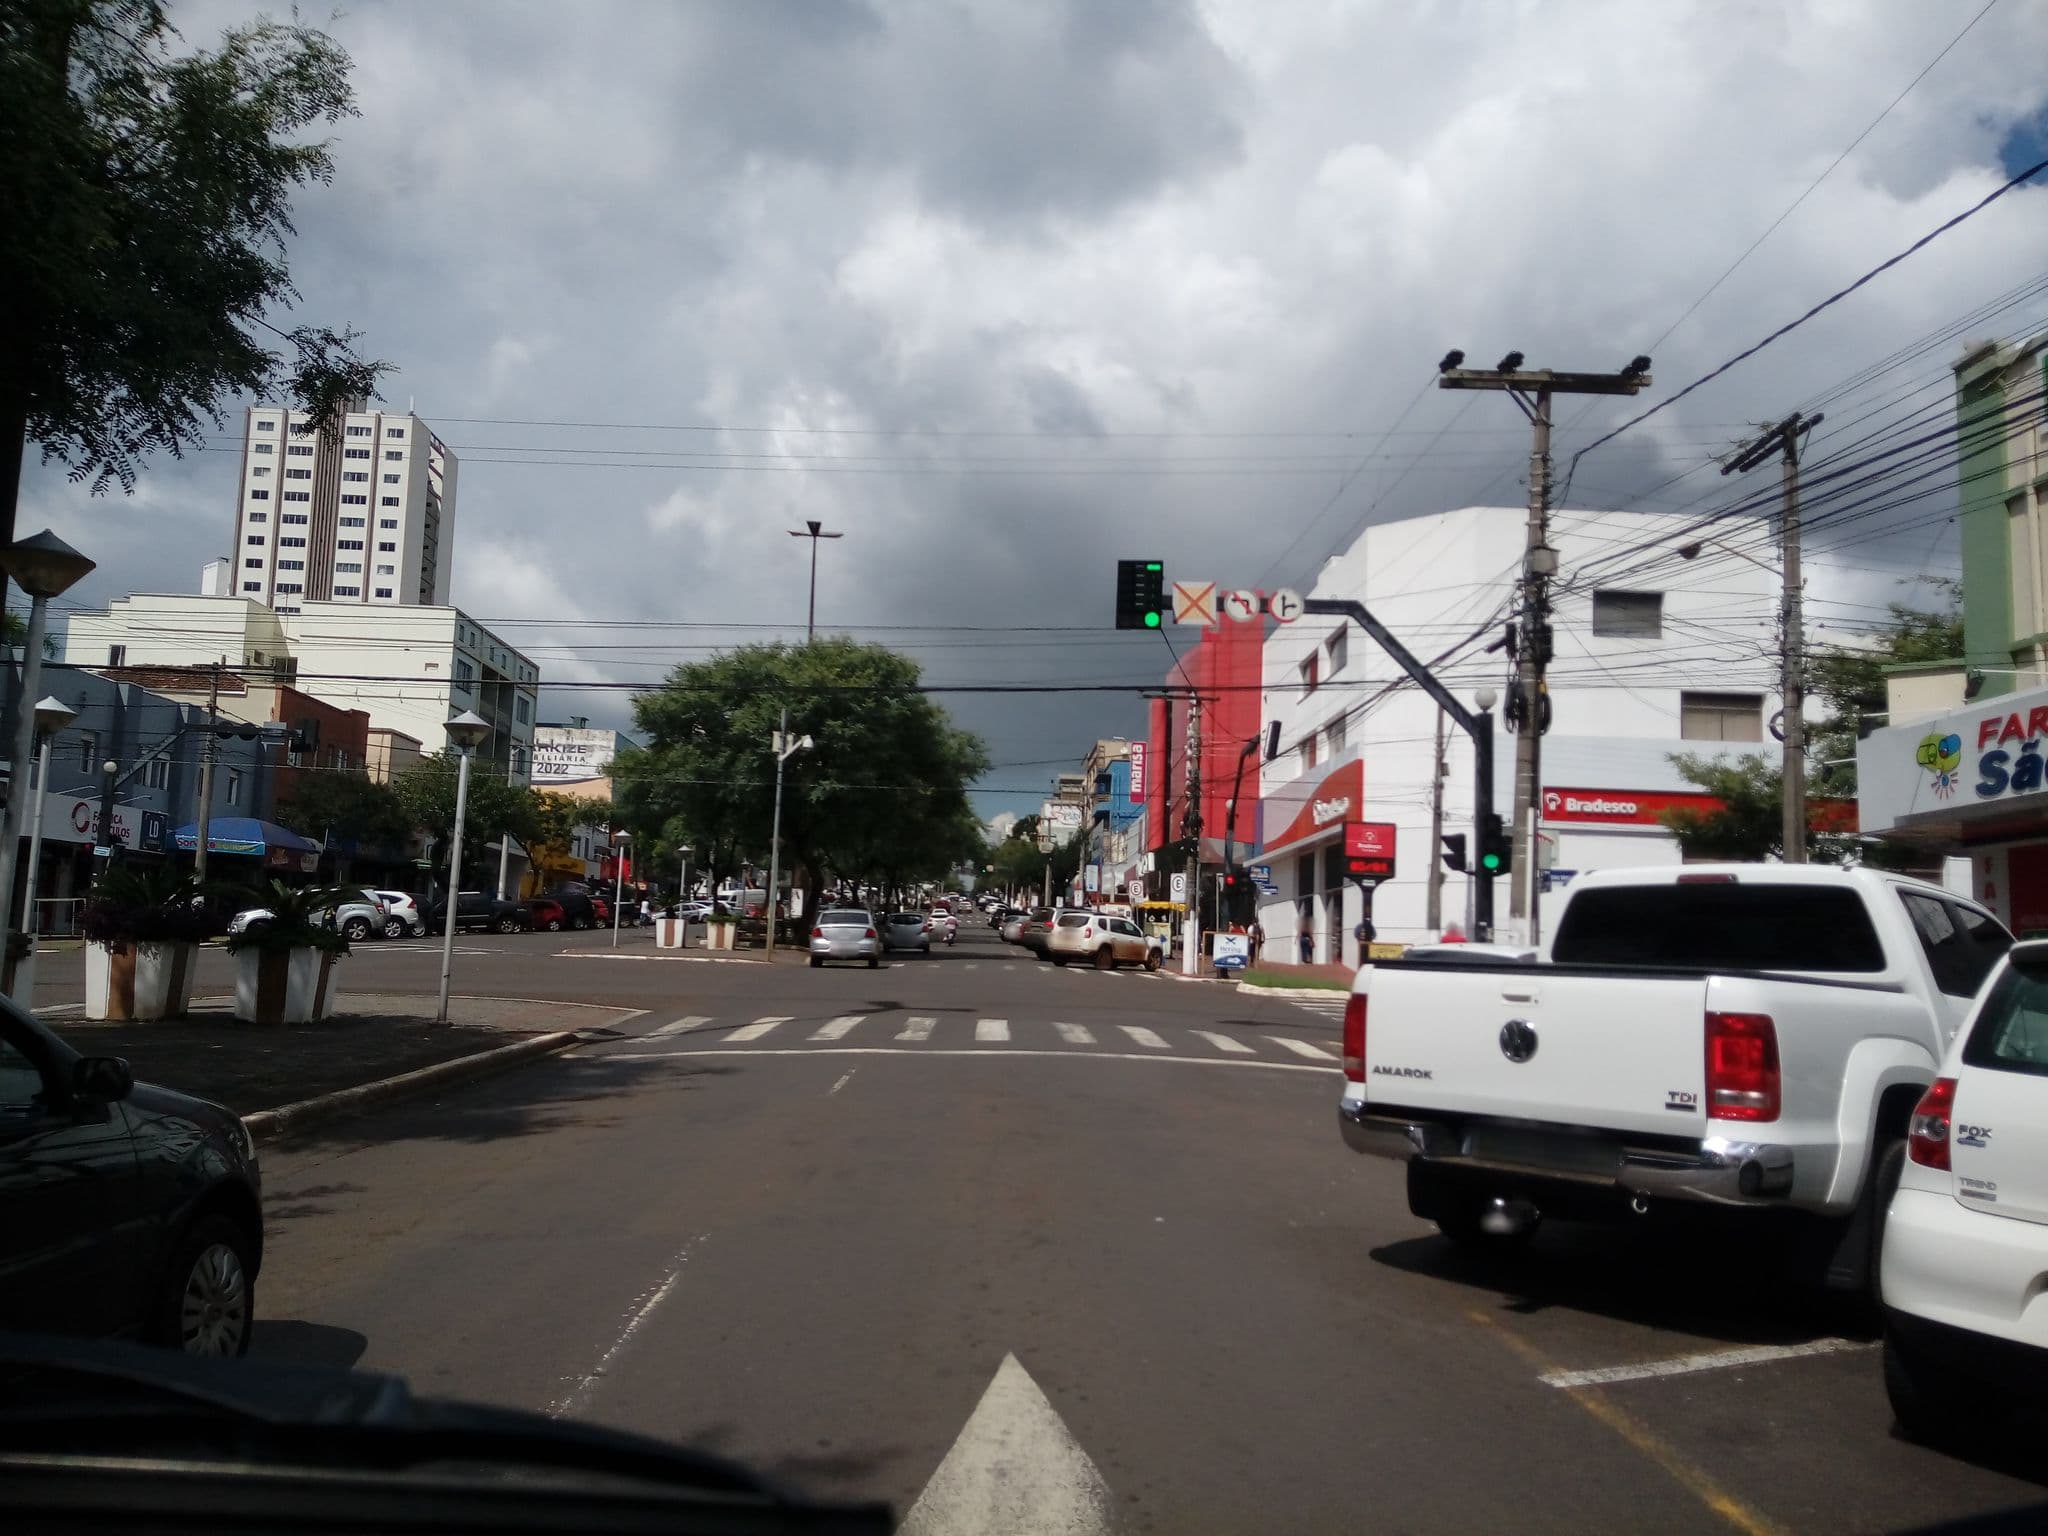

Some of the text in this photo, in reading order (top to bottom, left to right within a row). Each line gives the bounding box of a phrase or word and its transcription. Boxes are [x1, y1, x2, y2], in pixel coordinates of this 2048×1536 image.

[1977, 705, 2048, 750] FAR
[537, 762, 569, 775] 2022
[1131, 744, 1143, 793] marisa
[1975, 738, 2048, 797] Sã
[1565, 797, 1637, 814] Bradesco
[1372, 1065, 1432, 1080] AMAROK
[1668, 1090, 1698, 1104] TDI
[1958, 1124, 1993, 1139] FOX
[1959, 1176, 1997, 1191] TREND
